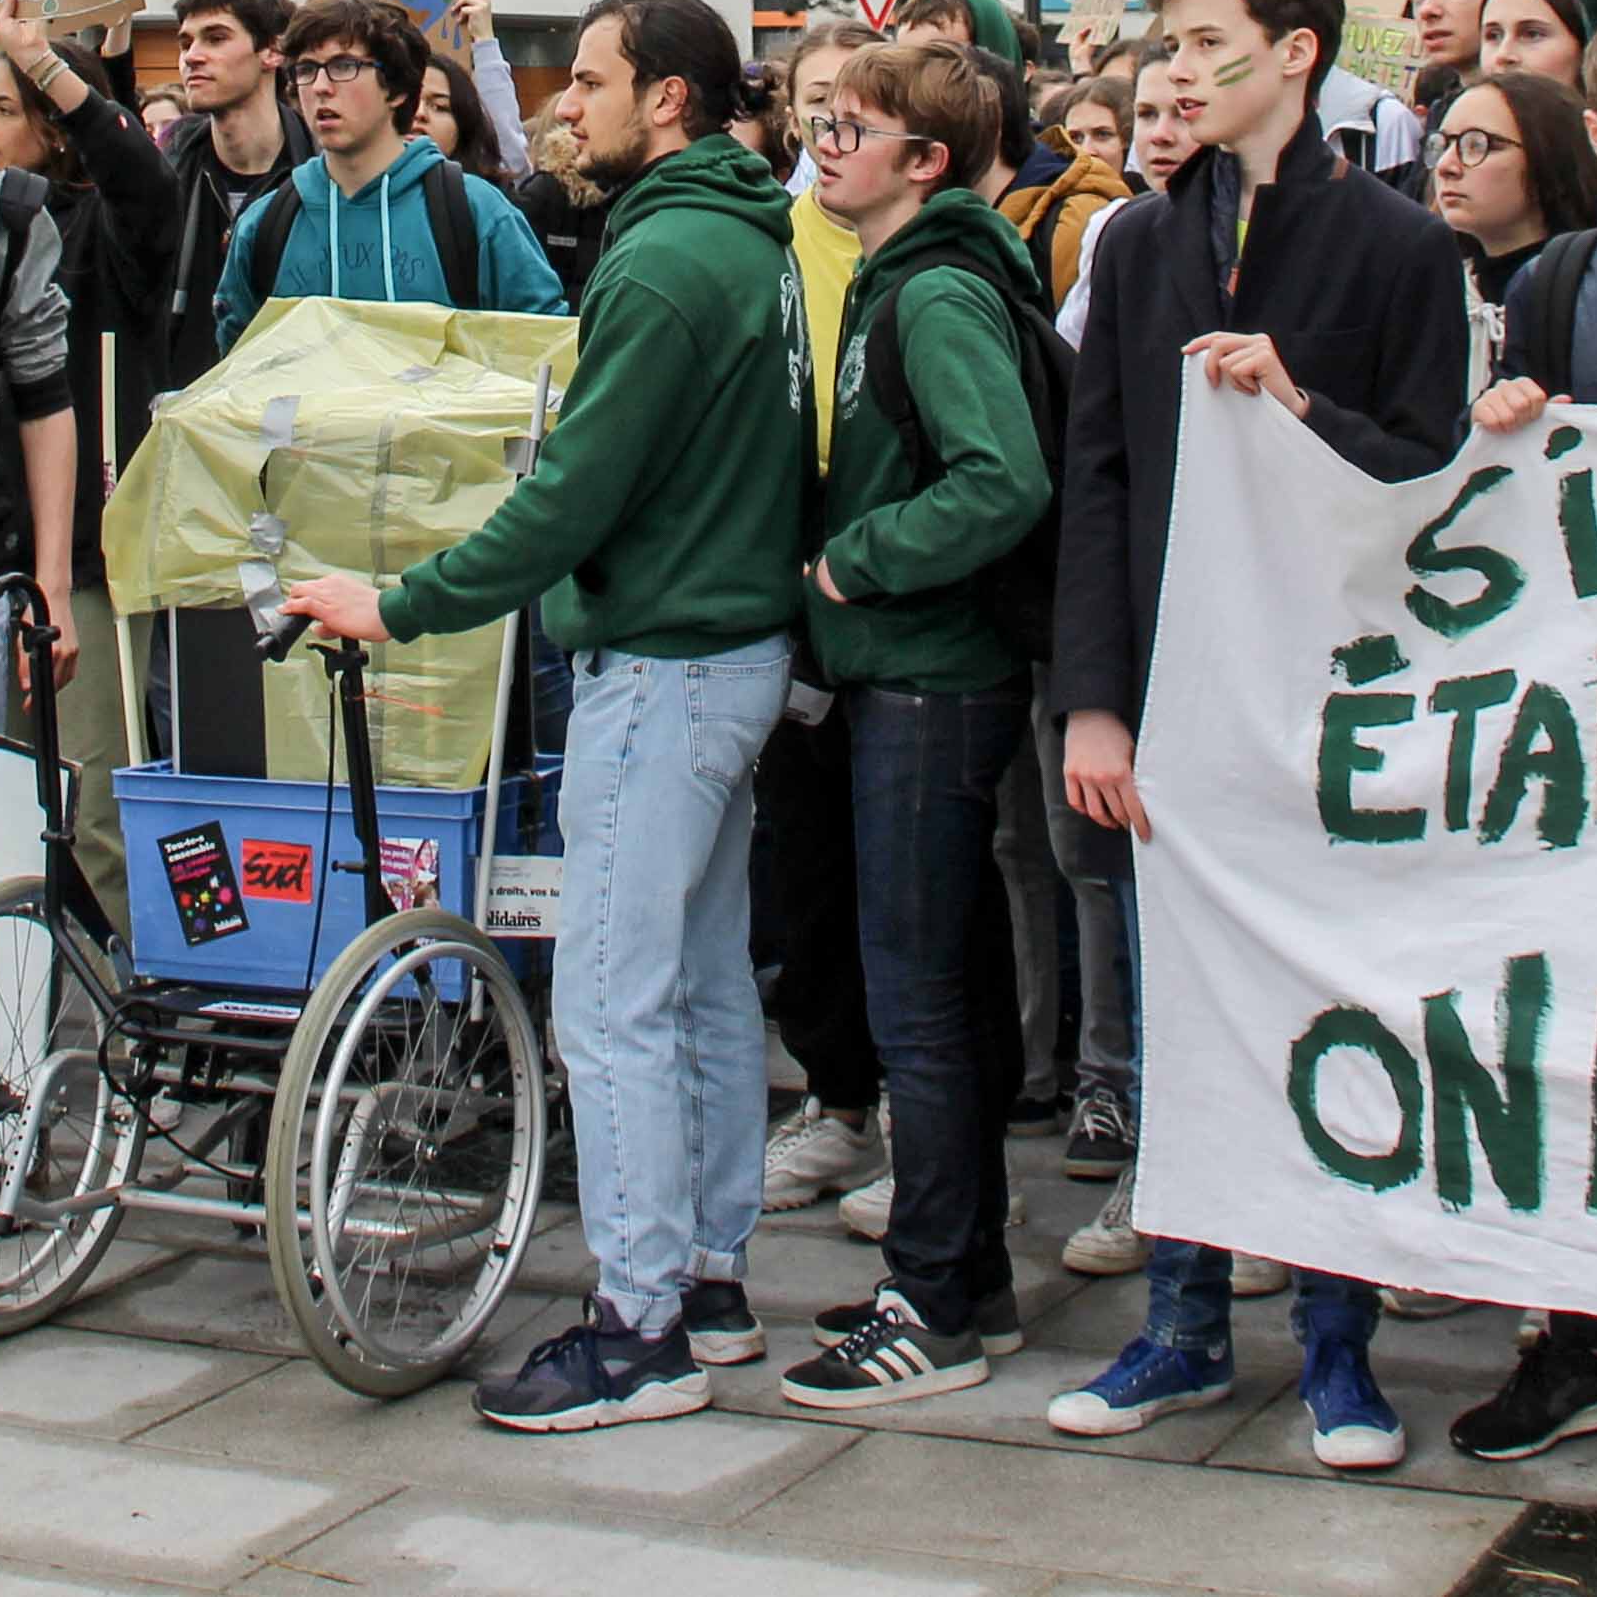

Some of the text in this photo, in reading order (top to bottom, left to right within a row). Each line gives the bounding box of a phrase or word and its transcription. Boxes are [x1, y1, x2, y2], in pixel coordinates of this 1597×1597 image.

[244, 852, 308, 892] Sud
[496, 886, 527, 898] droits,
[530, 888, 548, 896] vos
[1287, 952, 1554, 1214] ON
